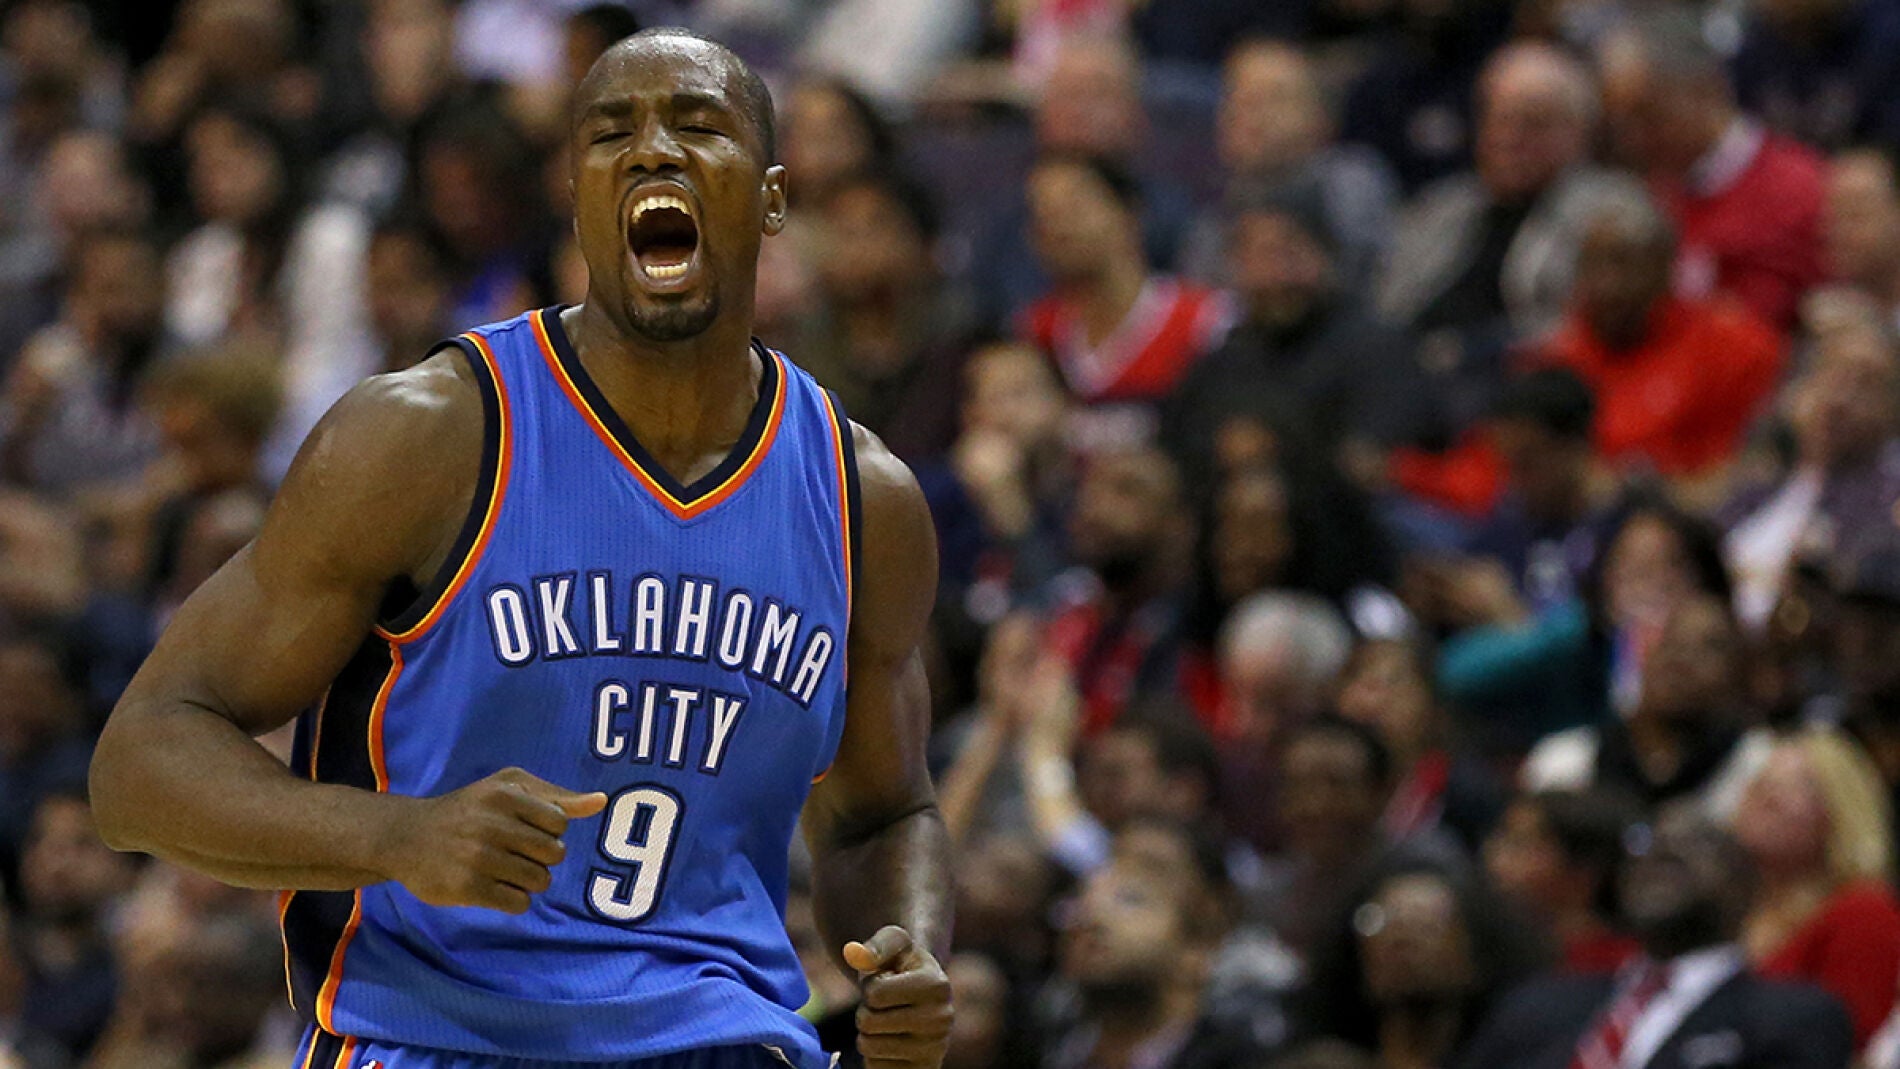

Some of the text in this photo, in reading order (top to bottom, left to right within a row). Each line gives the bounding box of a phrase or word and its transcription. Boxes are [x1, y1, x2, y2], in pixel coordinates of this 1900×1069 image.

[486, 571, 836, 708] OKLAHOMA
[592, 680, 748, 774] CITY
[585, 782, 685, 925] 9
